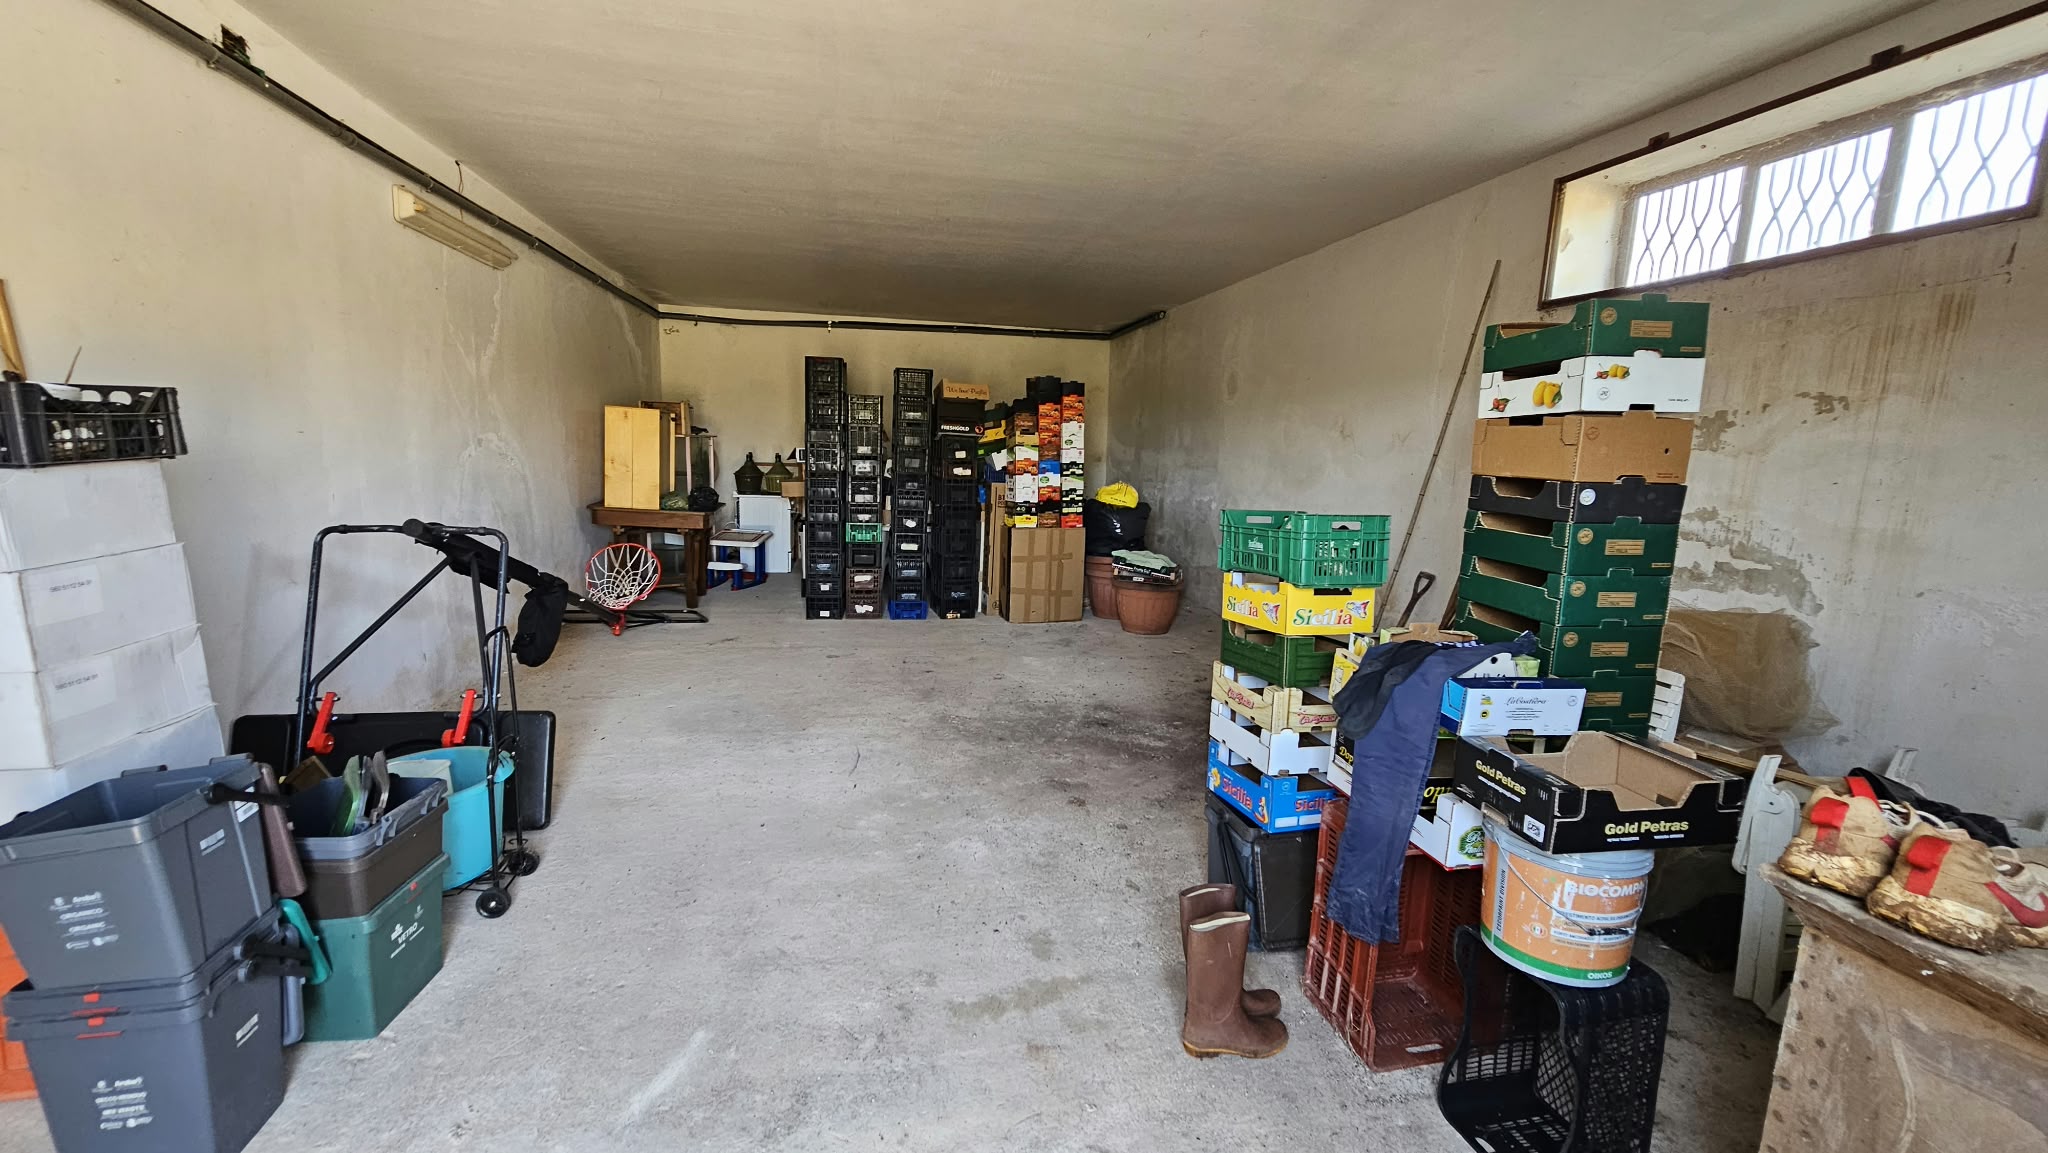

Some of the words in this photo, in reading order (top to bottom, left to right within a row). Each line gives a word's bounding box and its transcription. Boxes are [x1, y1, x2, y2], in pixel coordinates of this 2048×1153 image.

[1226, 595, 1258, 618] Sicilia
[1293, 608, 1352, 626] Sicilia
[1475, 760, 1495, 777] Gold
[1495, 770, 1527, 795] Petras
[1222, 778, 1253, 810] Sicilia
[1604, 822, 1638, 835] Gold
[1640, 820, 1689, 833] Petras
[397, 921, 418, 945] VETRO
[1587, 971, 1613, 979] OIKOS
